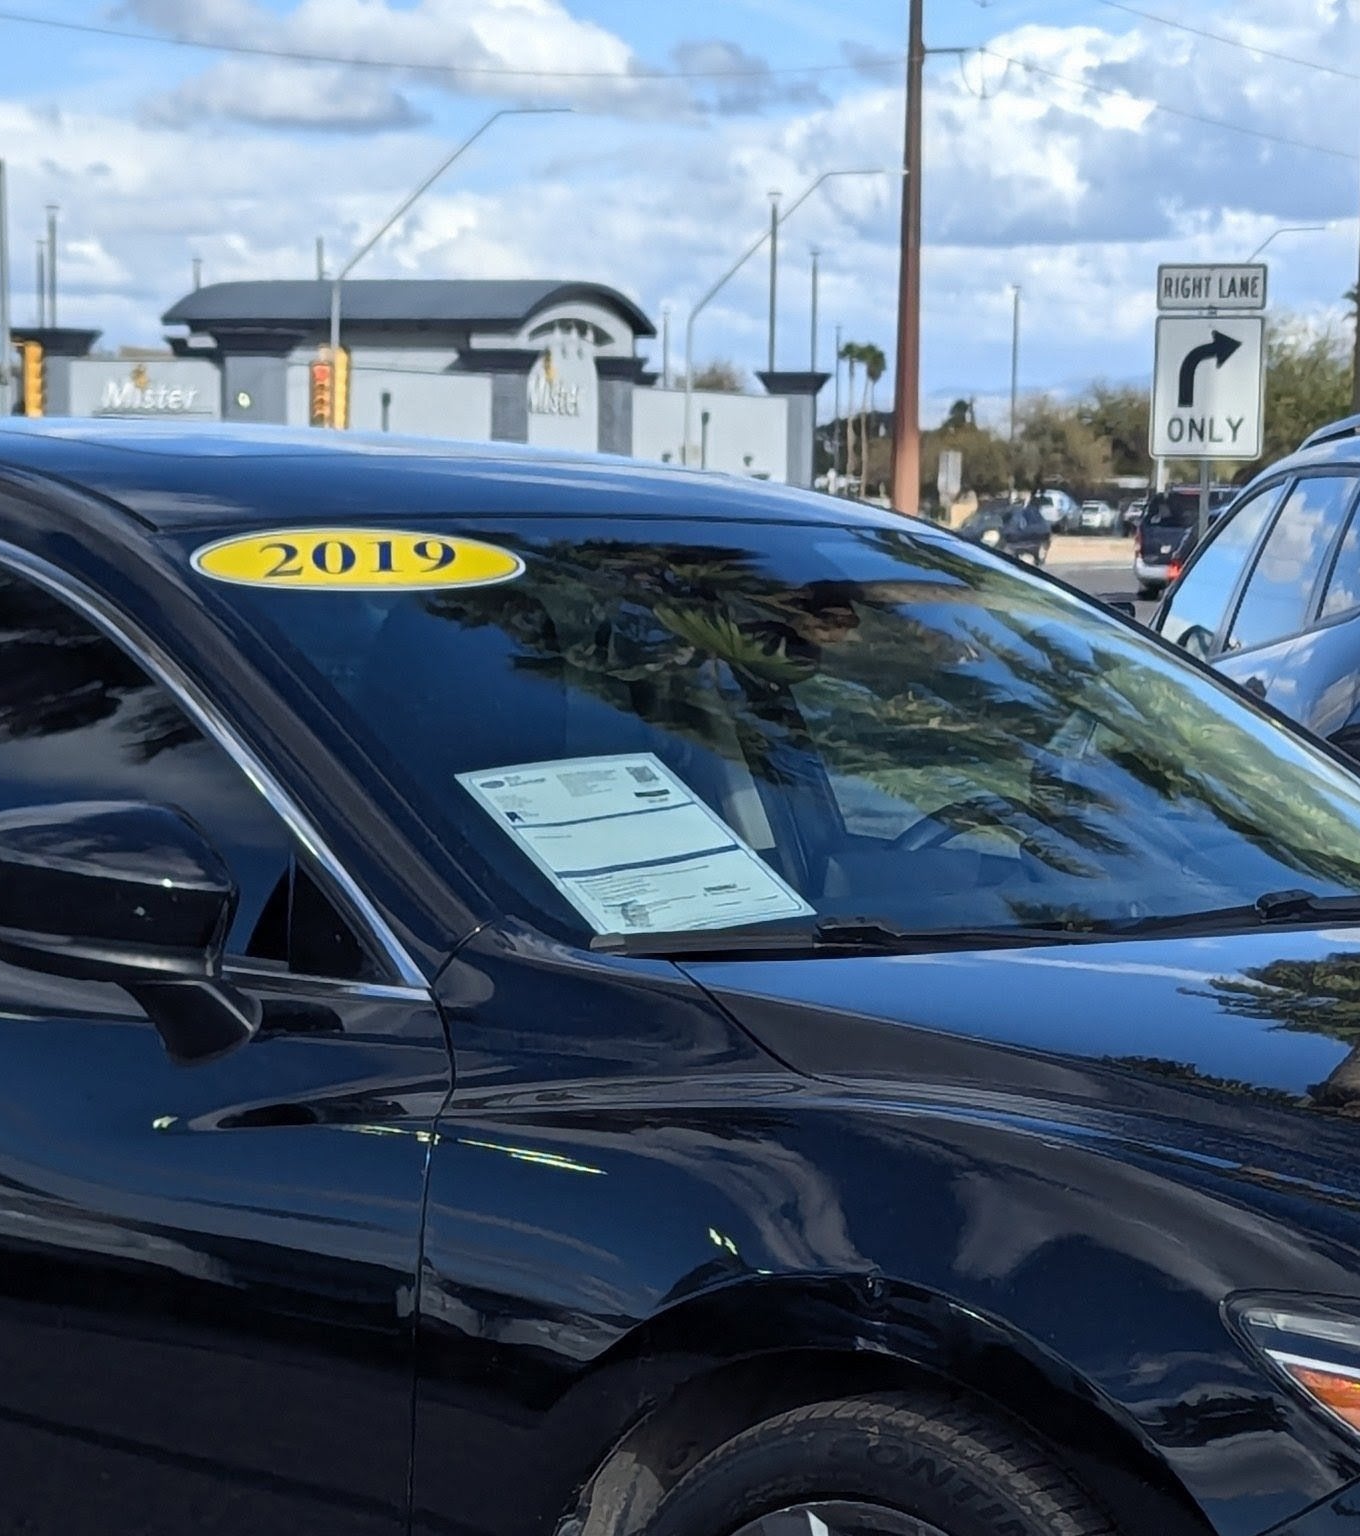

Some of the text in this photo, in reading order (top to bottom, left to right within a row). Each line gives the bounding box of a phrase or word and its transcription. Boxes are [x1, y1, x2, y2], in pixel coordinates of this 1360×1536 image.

[1163, 275, 1260, 299] RIGHT LANE
[100, 379, 200, 410] Mister
[1166, 416, 1244, 443] ONLY
[258, 540, 457, 578] 2019
